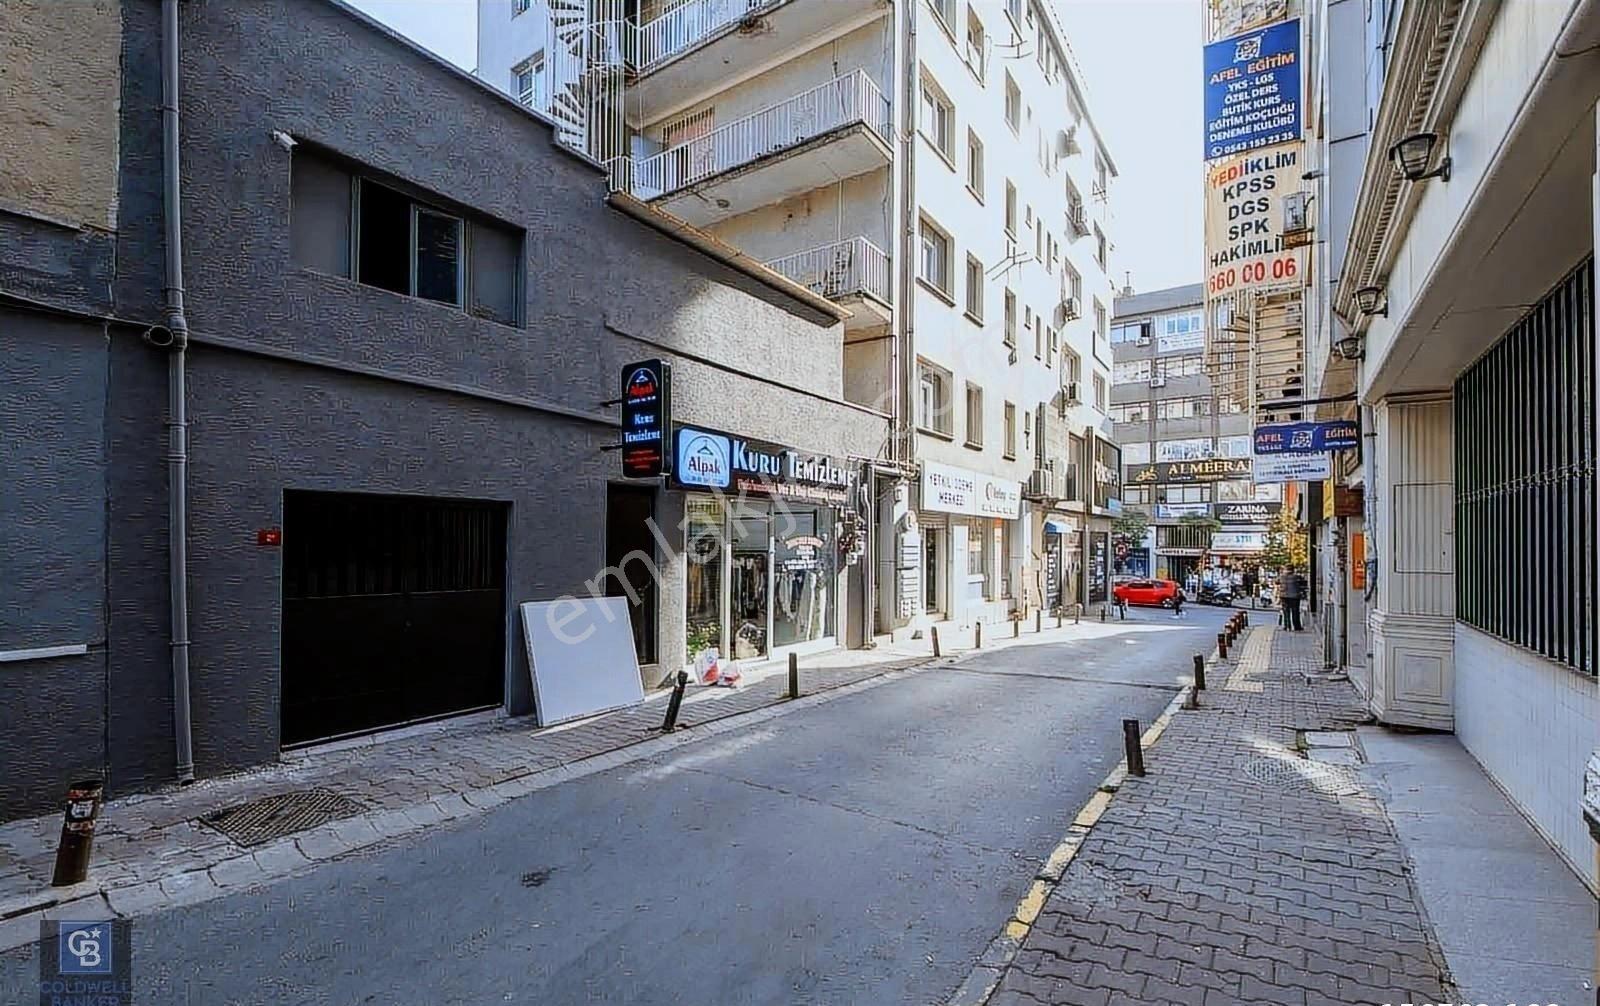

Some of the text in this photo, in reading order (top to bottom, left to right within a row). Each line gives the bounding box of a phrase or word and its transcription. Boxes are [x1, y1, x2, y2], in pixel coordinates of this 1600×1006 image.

[1209, 67, 1242, 85] AFEL
[1255, 72, 1275, 85] LGS
[1251, 83, 1279, 98] DERS
[1253, 94, 1281, 109] KURS
[1223, 174, 1276, 203] KPSS
[1228, 197, 1270, 221] DGS
[1228, 217, 1270, 241] SPK
[1272, 257, 1297, 280] 06
[687, 456, 721, 477] Alpak
[733, 440, 780, 475] KURU
